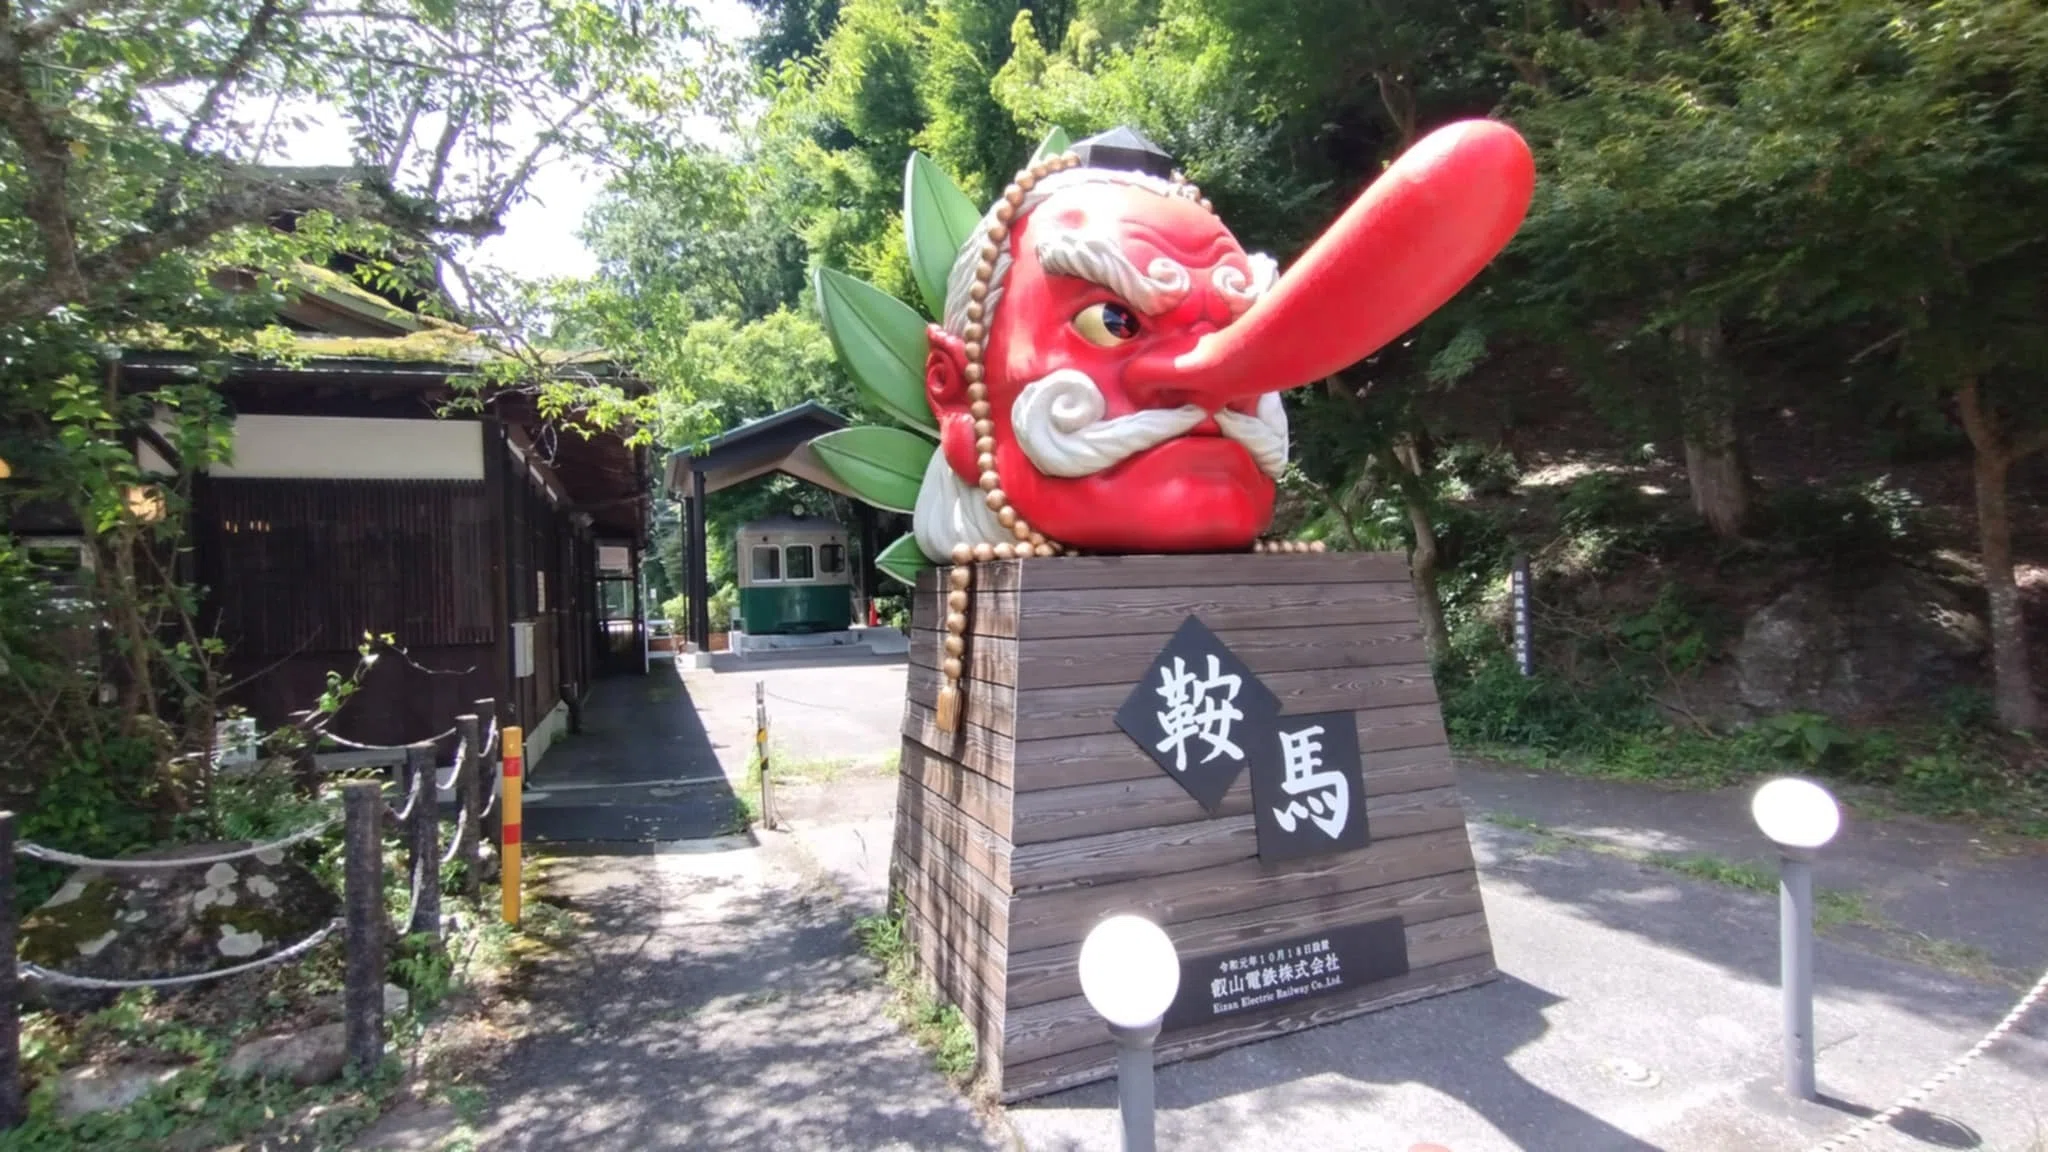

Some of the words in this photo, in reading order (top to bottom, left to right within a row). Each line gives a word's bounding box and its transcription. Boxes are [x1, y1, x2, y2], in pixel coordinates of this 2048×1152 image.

[1211, 952, 1341, 998] 叡山電鉄株式会社
[1213, 1001, 1239, 1014] Eizan
[1241, 992, 1275, 1008] Electric
[1276, 984, 1309, 1000] Railway
